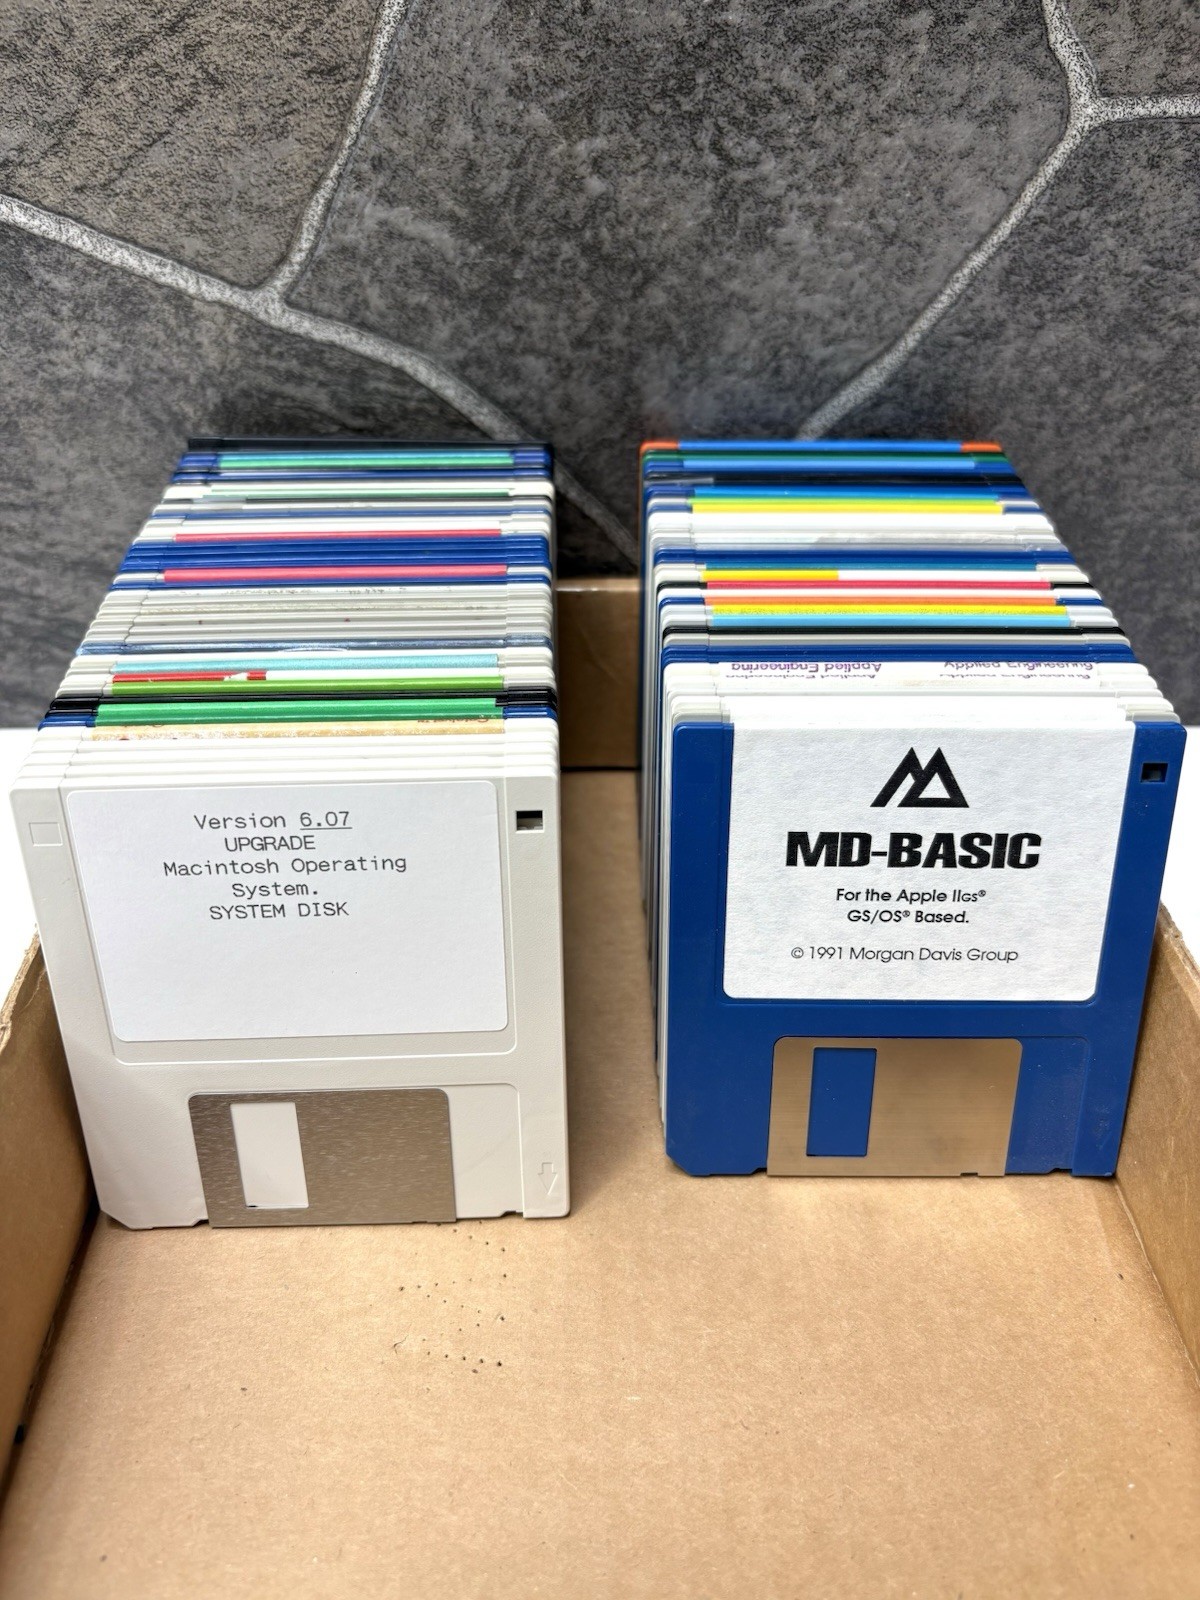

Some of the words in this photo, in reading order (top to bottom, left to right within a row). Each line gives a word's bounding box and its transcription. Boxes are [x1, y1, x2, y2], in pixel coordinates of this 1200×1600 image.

[193, 812, 286, 830] Version
[299, 810, 354, 831] 6.07
[224, 834, 316, 852] UPGRADE
[785, 831, 1042, 870] MD-BASIC
[163, 858, 279, 877] Macintosh
[291, 855, 407, 876] Operating
[231, 881, 318, 899] System.
[836, 888, 862, 902] For
[864, 888, 892, 902] the
[895, 888, 948, 905] Apple
[209, 903, 286, 920] SYSTEM
[297, 901, 350, 917] DISK
[914, 910, 970, 924] Based.
[809, 946, 843, 960] 1991
[849, 946, 915, 964] Morgan
[918, 947, 963, 961] Davis
[966, 947, 1019, 964] Group
